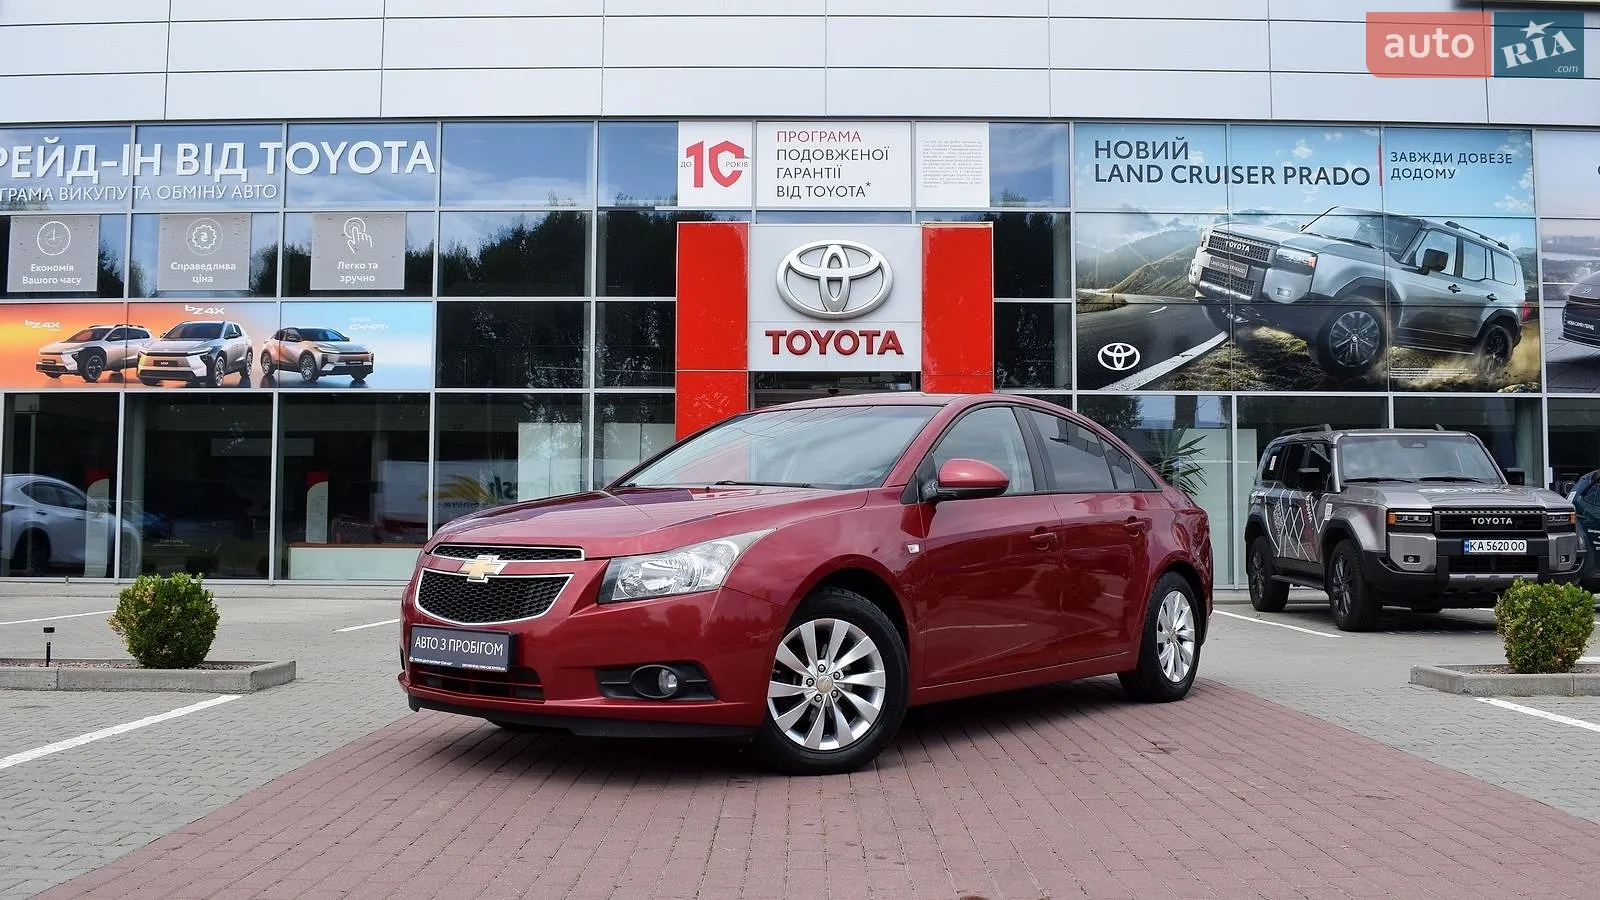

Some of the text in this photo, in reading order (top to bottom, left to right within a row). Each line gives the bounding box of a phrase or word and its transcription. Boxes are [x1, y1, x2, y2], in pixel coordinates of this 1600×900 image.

[777, 131, 862, 143] ПРОГРАМА
[1094, 136, 1189, 160] НОВИЙ
[777, 146, 889, 163] ПОДОВЖЕНОЇ
[1390, 151, 1513, 165] ЗАВЖДИ ДОВЕЗЕ
[176, 142, 248, 183] ВІД
[259, 140, 436, 175] TOYOTA
[680, 161, 693, 169] ДО
[777, 165, 842, 180] ГАРАНТІЇ
[1094, 164, 1371, 186] LAND CRUISER PRADO
[1390, 168, 1456, 181] ДОДОМУ
[59, 186, 128, 201] ВИКУПУ
[132, 185, 152, 200] ТА
[157, 184, 227, 200] ОБМІНУ
[231, 184, 278, 199] АВТО
[777, 186, 802, 199] ВІД
[1225, 240, 1250, 252] TOYOTA
[30, 264, 74, 272] Економія
[171, 262, 237, 272] Справедлива
[337, 261, 379, 271] Легко та
[22, 275, 82, 285] Вашого часу
[192, 275, 214, 285] ціна
[340, 276, 376, 285] зручно
[765, 330, 904, 355] TOYOTA
[1471, 517, 1513, 525] TOYOTA
[1469, 541, 1484, 551] KA
[1486, 541, 1509, 551] 5620
[414, 635, 504, 656] АВТО З ПРОБІГОМ
